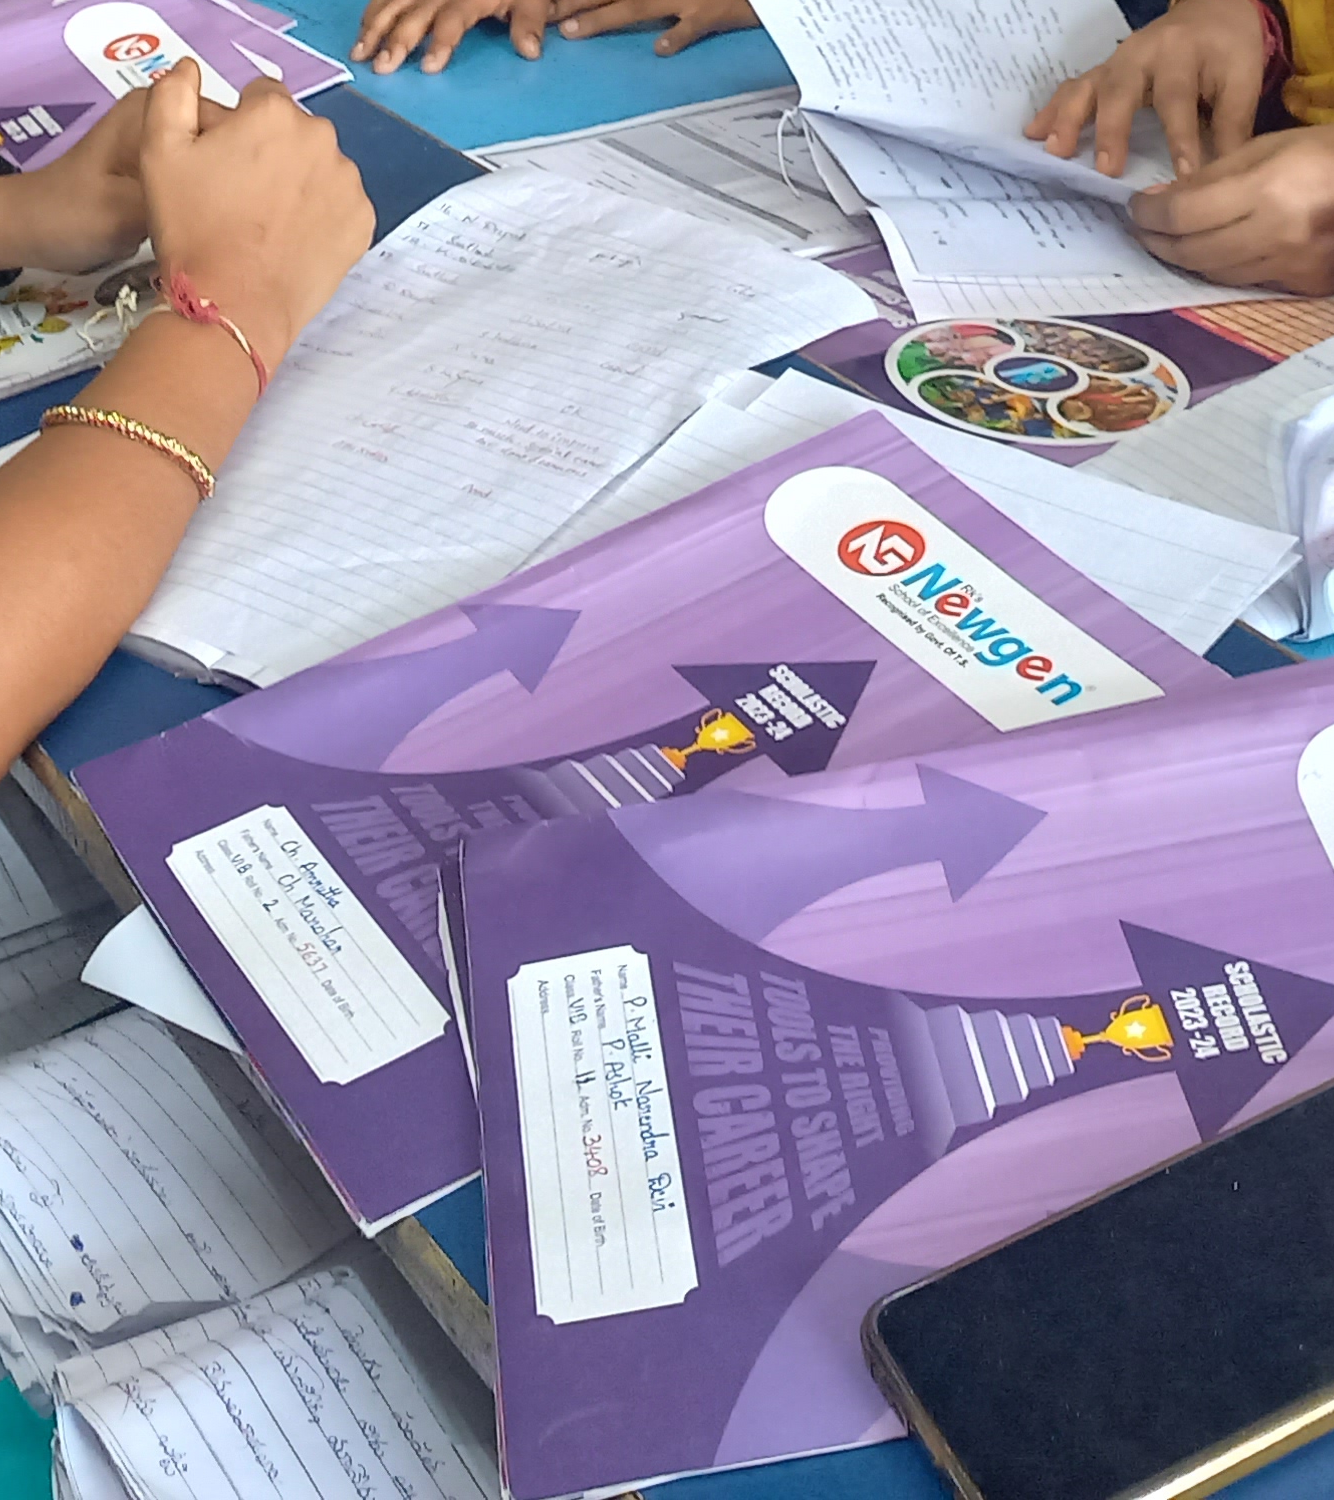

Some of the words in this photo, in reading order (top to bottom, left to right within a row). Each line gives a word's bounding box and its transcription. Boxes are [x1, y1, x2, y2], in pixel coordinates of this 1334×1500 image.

[889, 583, 923, 612] School
[927, 614, 975, 653] Excellence
[900, 562, 1083, 706] Newgen
[262, 899, 280, 913] 2
[626, 1016, 653, 1064] Malli
[672, 960, 764, 1077] THEIR
[760, 970, 823, 1064] TOOLS
[827, 1024, 866, 1069] THE
[1170, 987, 1222, 1061] 2023-24
[1201, 983, 1251, 1053] RECORD
[1224, 960, 1289, 1066] SCHOLASTIC
[604, 1061, 634, 1111] Ashok
[780, 1067, 832, 1109] TO
[582, 1134, 609, 1178] 3408
[693, 1083, 794, 1269] CAREER
[790, 1111, 856, 1232] SHAPE
